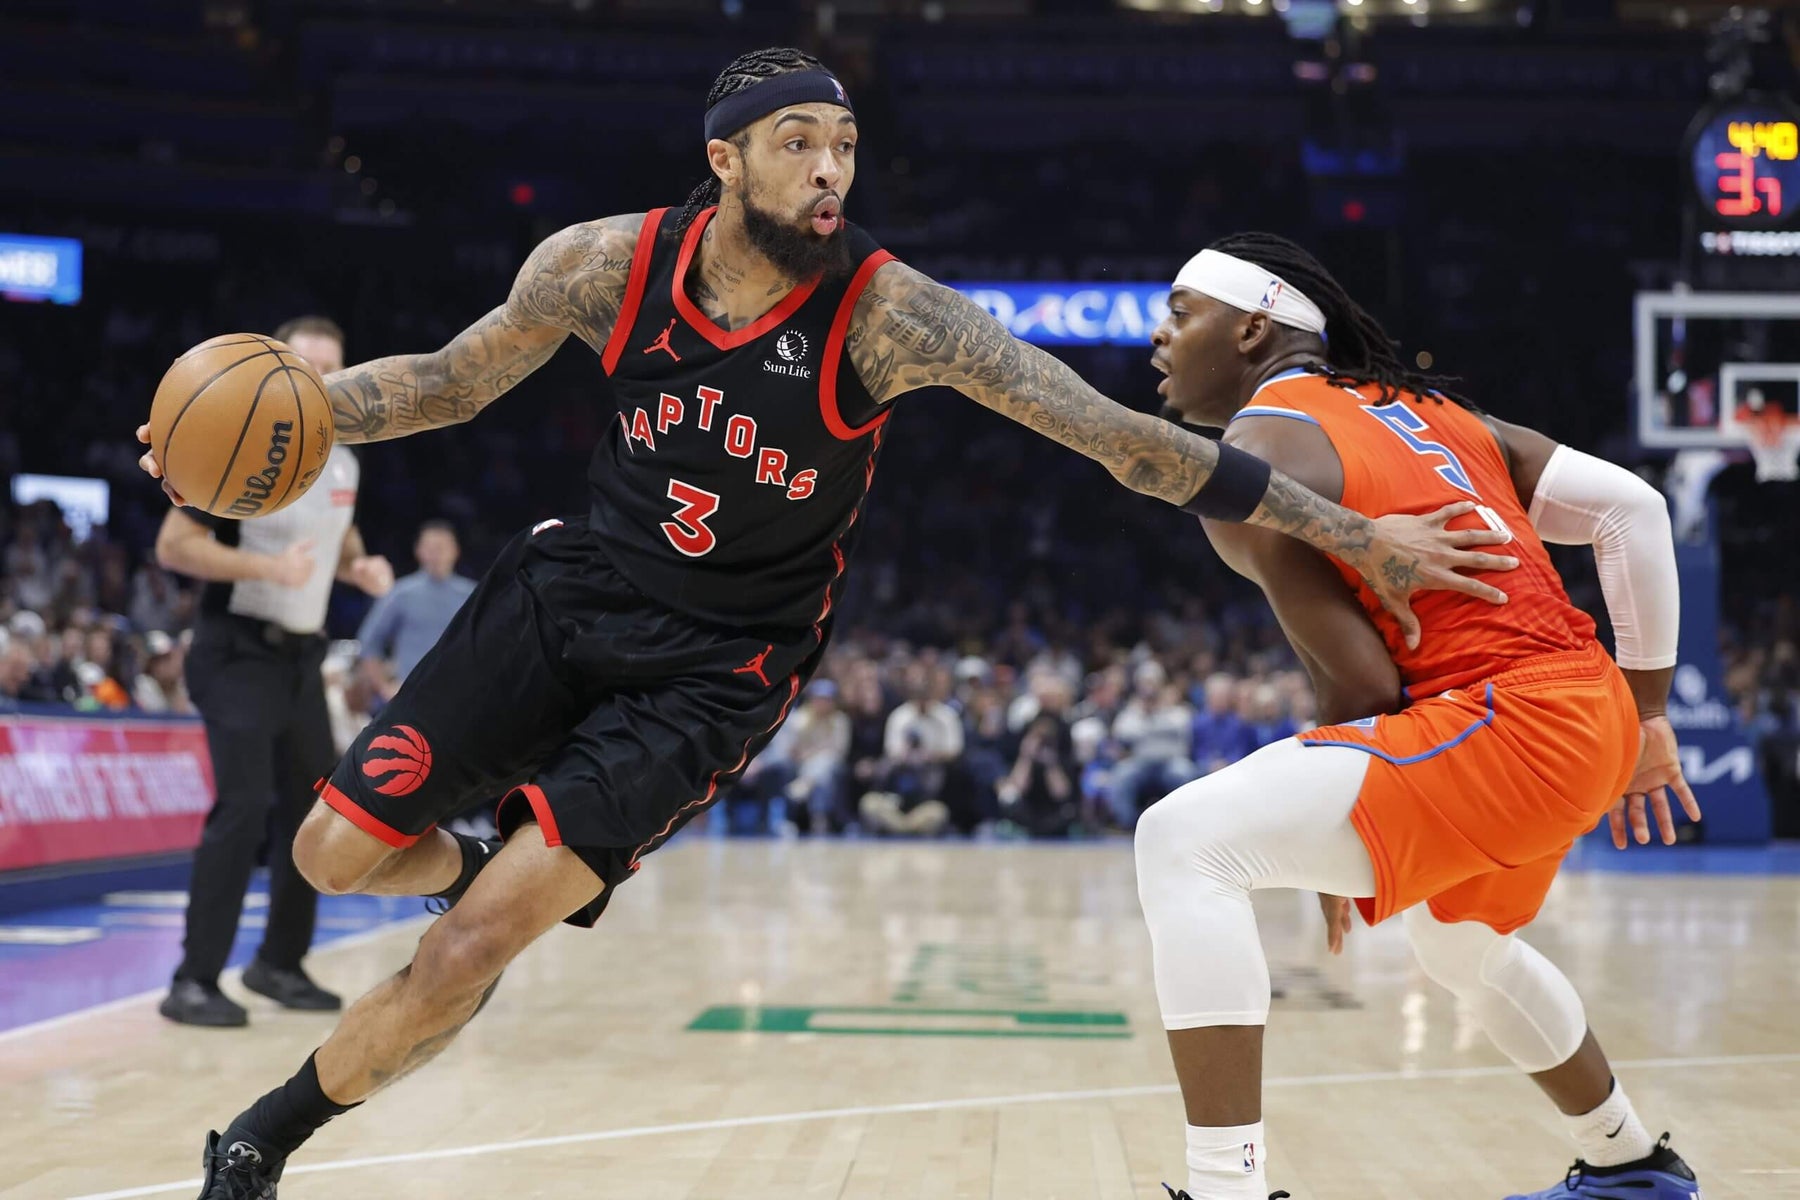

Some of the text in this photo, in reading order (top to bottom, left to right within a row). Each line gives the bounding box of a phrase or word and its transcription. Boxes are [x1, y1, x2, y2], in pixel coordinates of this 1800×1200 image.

[763, 360, 811, 379] Sun Life
[222, 419, 293, 516] Wilson
[1358, 400, 1484, 501] 5
[660, 478, 720, 557] 3
